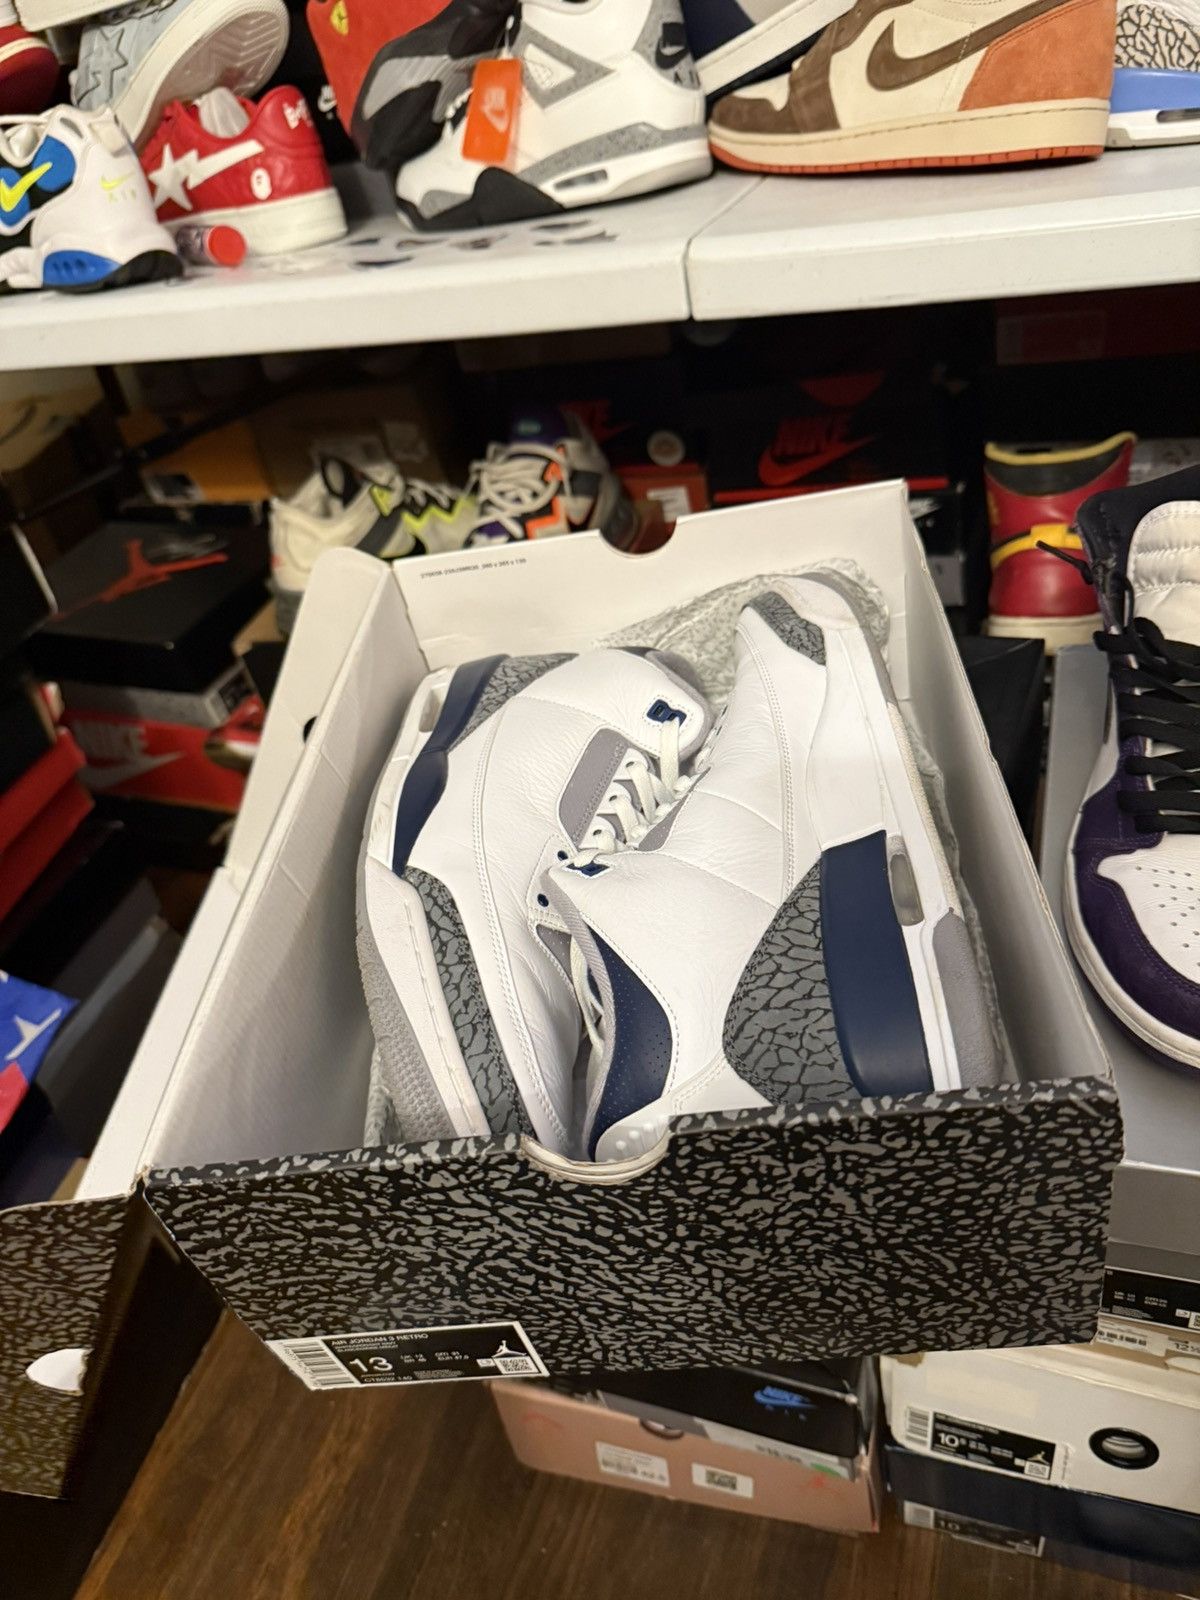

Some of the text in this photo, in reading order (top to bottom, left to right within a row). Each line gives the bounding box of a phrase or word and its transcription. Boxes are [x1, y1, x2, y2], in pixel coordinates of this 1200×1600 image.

[350, 1336, 387, 1344] JORDAN
[396, 1333, 429, 1341] RETRO
[349, 1356, 393, 1372] 13
